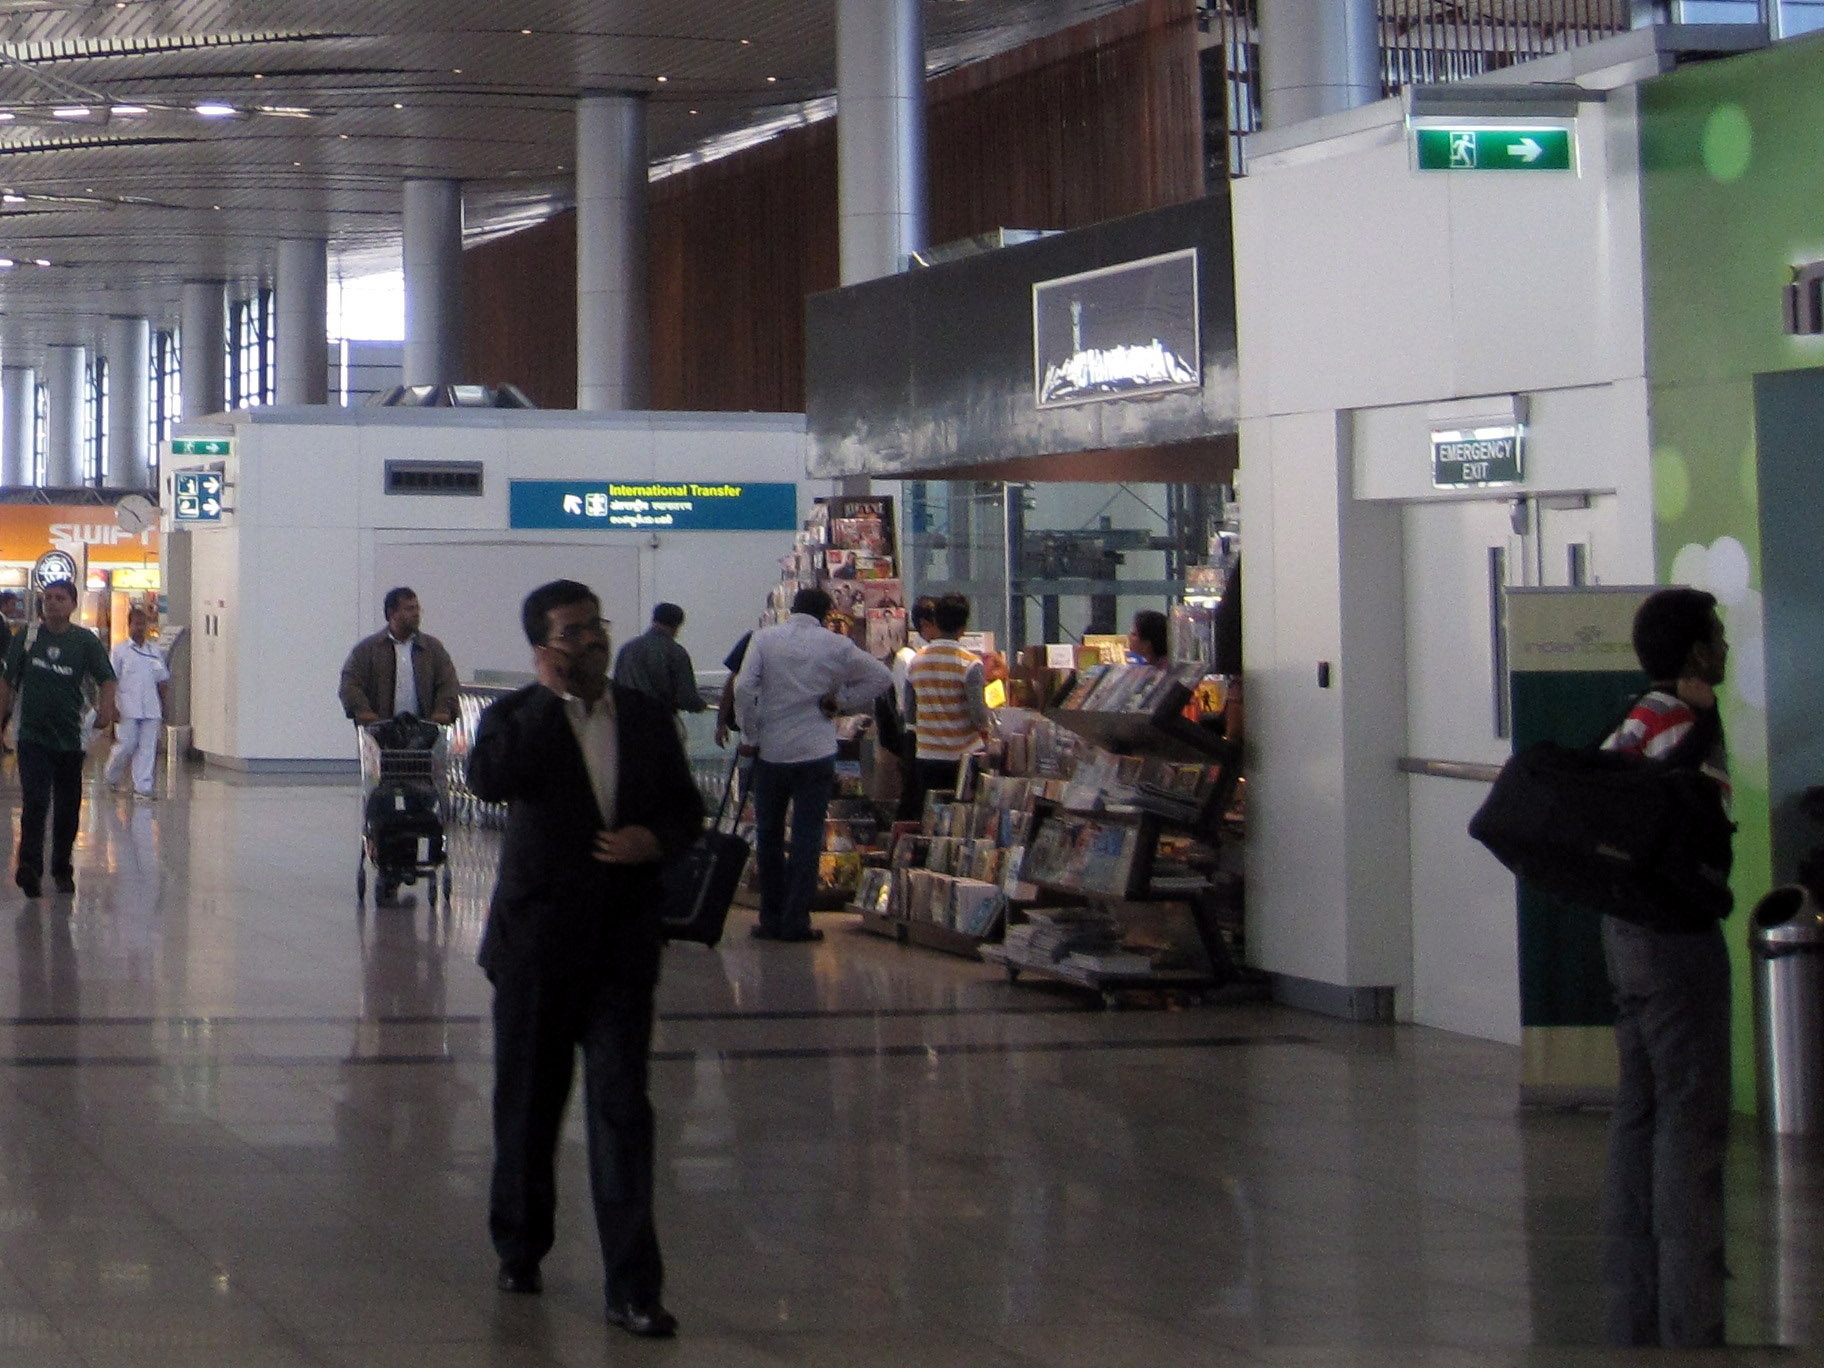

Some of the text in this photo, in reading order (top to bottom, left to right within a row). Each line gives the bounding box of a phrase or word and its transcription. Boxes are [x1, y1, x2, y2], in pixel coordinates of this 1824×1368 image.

[1439, 439, 1512, 462] EMERGENCY
[1462, 462, 1488, 480] EXIT
[609, 484, 742, 497] International Transfer
[48, 523, 157, 546] SWIFT
